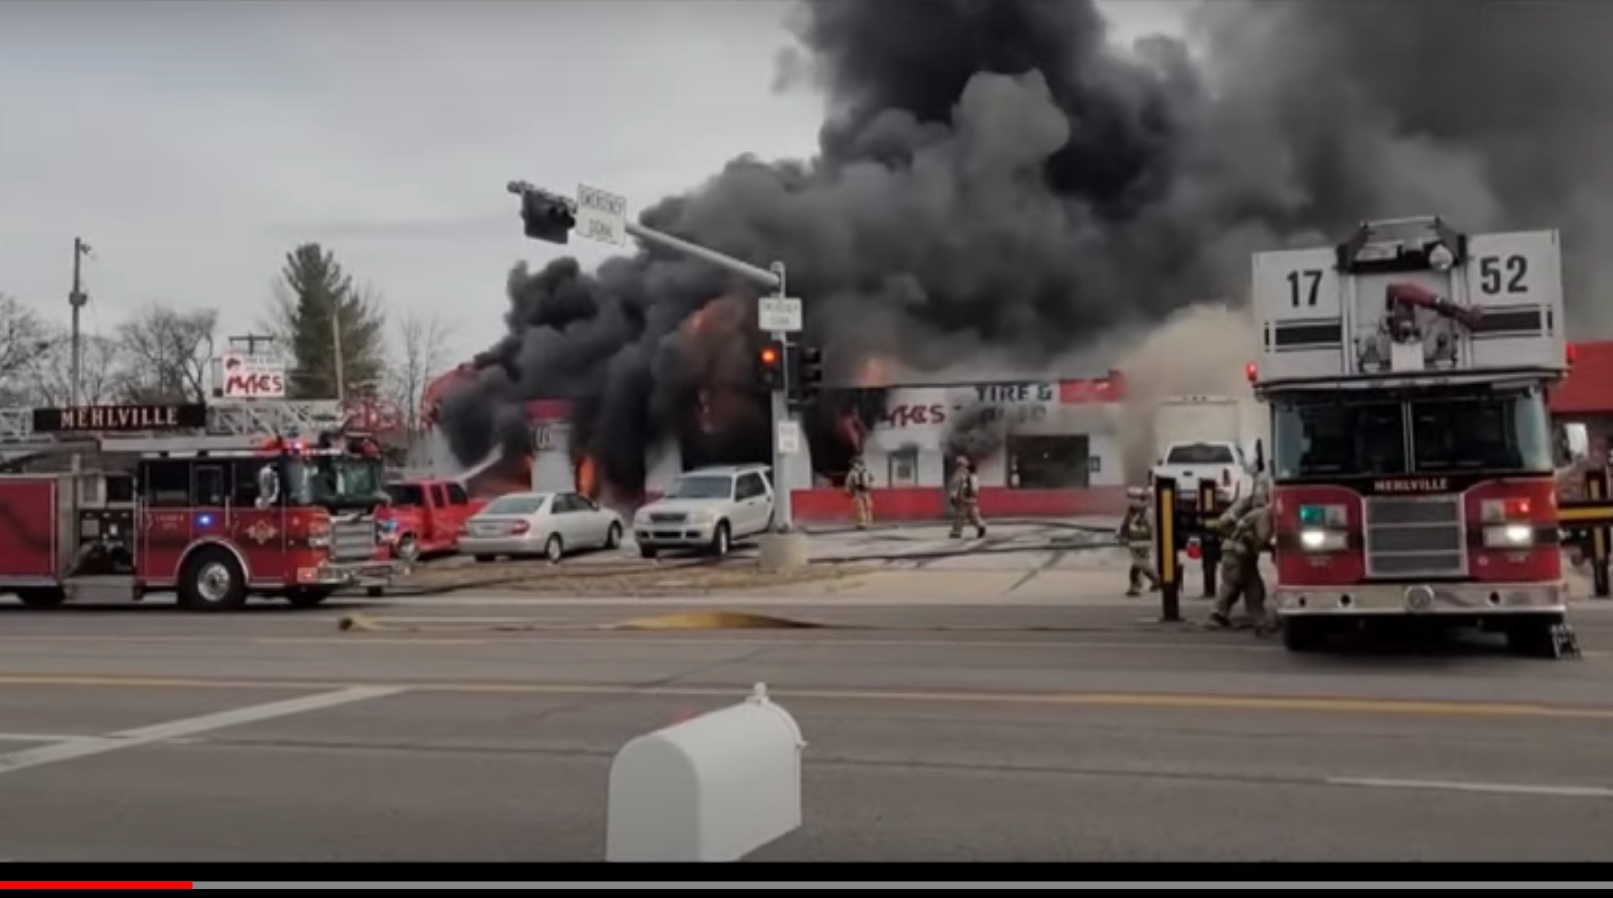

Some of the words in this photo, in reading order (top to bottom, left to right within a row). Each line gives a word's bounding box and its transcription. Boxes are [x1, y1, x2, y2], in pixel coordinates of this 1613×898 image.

[1480, 255, 1528, 295] 52
[1287, 269, 1324, 307] 17
[975, 383, 1031, 401] TIRE
[60, 406, 179, 429] MEHLVILLE
[1374, 478, 1448, 492] MEHLVILLE
